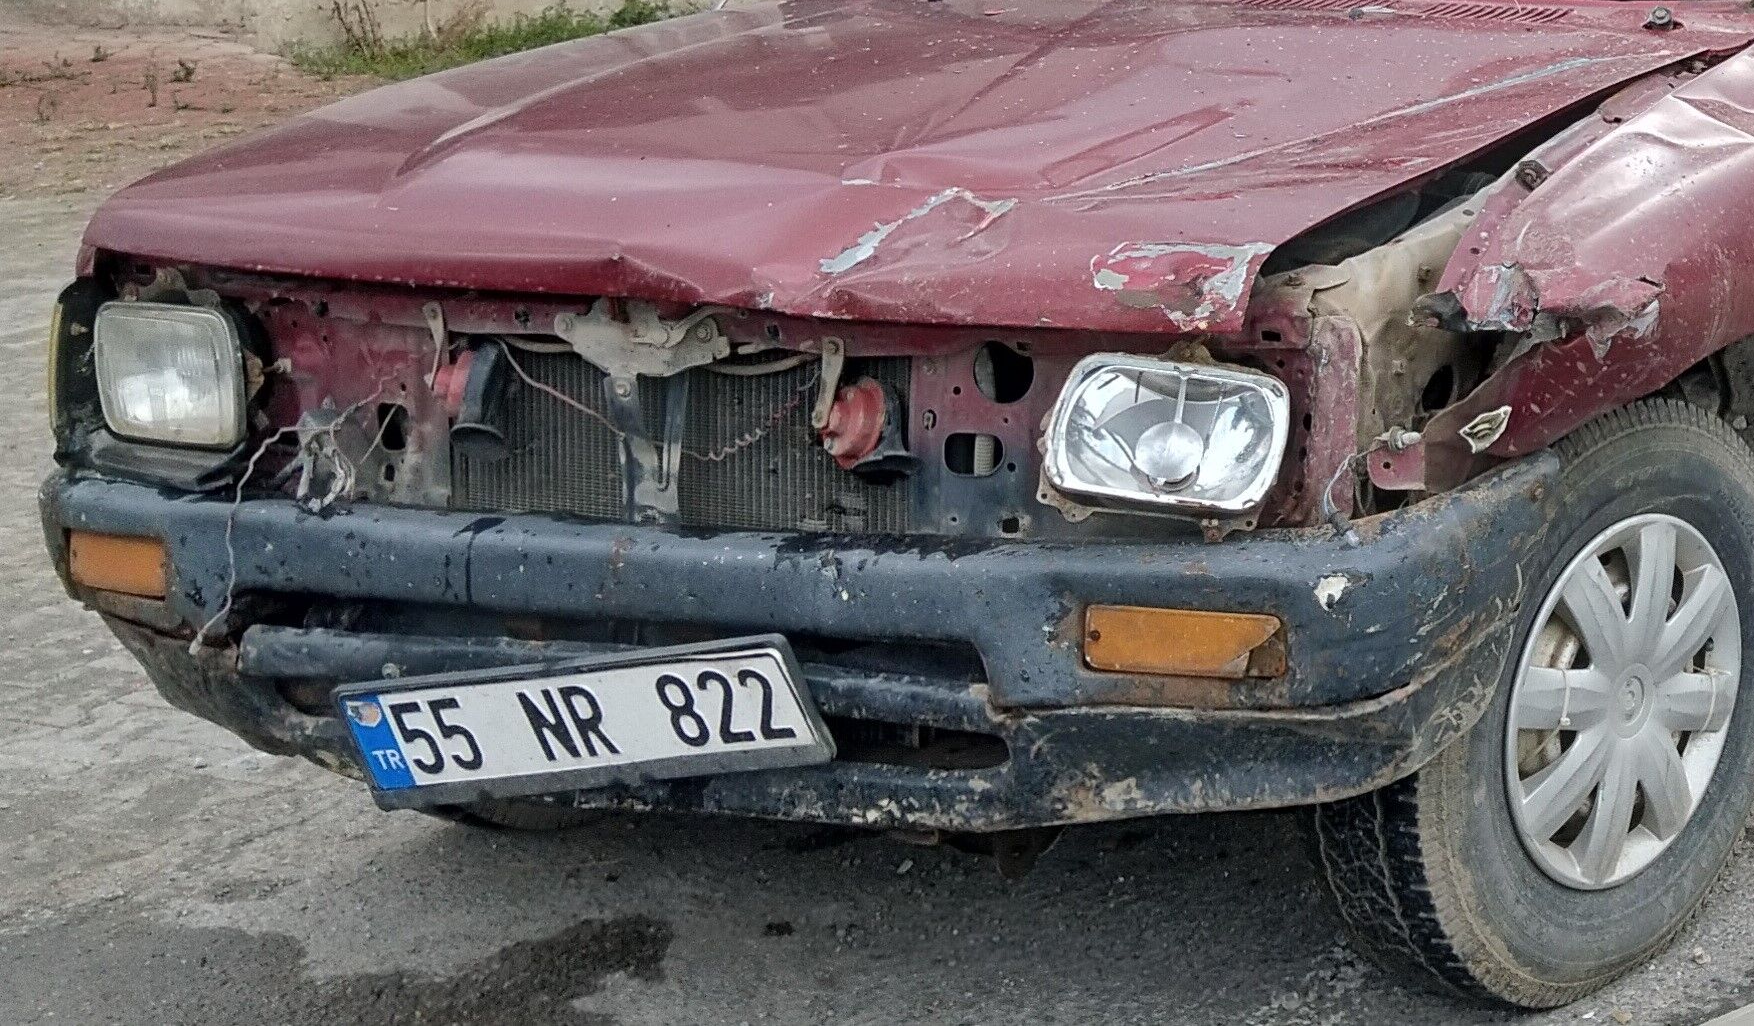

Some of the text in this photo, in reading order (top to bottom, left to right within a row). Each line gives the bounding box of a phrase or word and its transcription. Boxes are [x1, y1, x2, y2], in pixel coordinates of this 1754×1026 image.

[389, 667, 798, 774] 55 NR 822
[371, 748, 406, 771] TR
